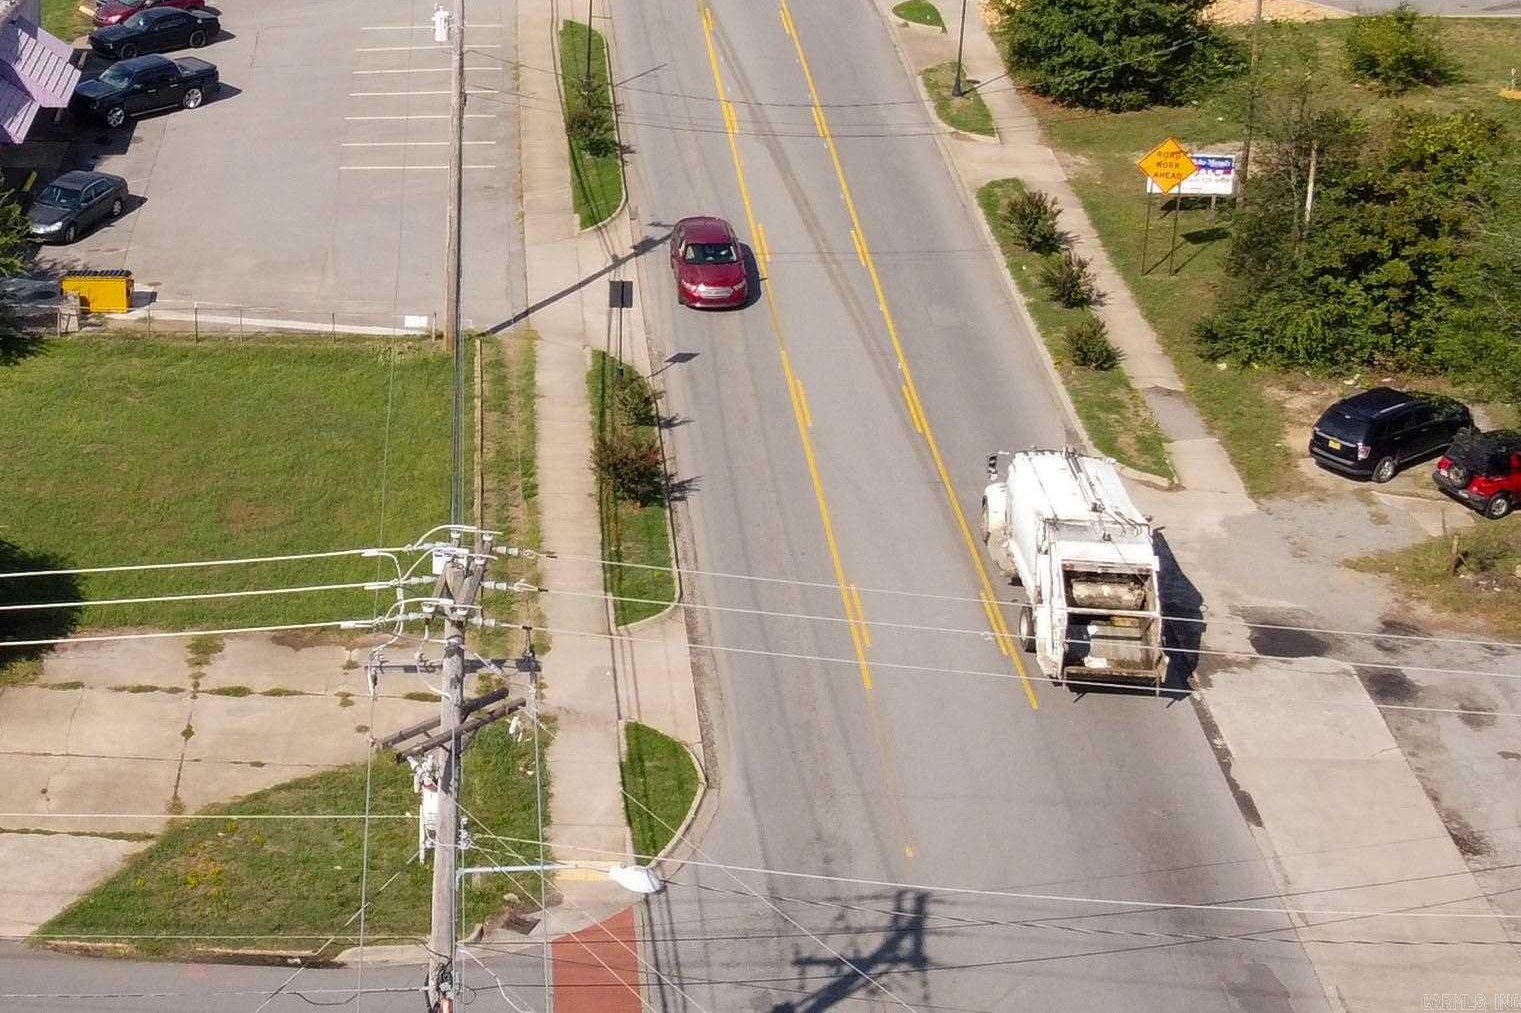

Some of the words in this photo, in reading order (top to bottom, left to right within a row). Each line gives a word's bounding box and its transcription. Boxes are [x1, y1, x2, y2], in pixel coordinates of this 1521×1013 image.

[1156, 150, 1182, 159] ROAD
[1156, 161, 1181, 169] WORK
[1153, 172, 1182, 180] AHEAD
